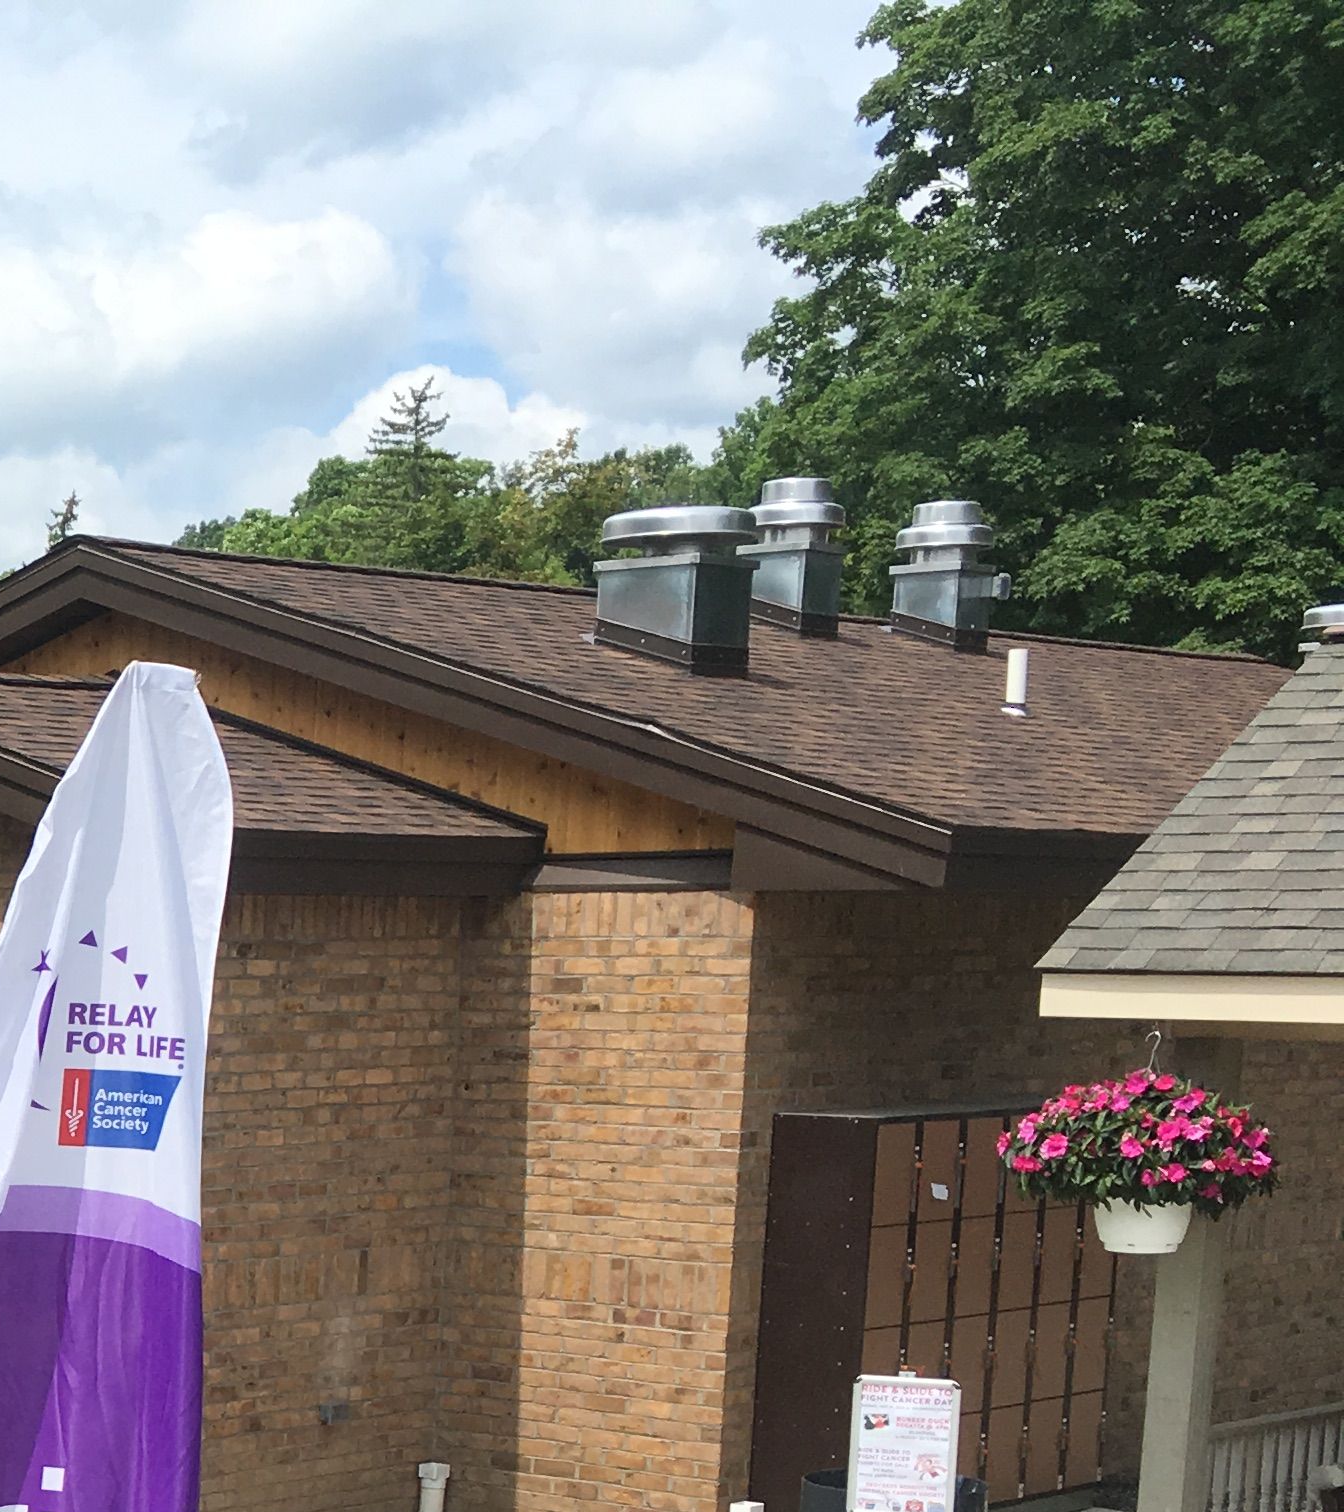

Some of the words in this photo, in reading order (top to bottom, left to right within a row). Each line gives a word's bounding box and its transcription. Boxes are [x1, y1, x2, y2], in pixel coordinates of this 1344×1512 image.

[67, 1002, 158, 1029] RELAY
[65, 1031, 127, 1056] FOR
[136, 1033, 186, 1061] LIFE
[94, 1088, 163, 1106] American
[93, 1102, 148, 1117] Cancer
[92, 1115, 149, 1135] Society
[862, 1384, 888, 1393] RIDE
[903, 1386, 934, 1396] SLIDE
[937, 1388, 953, 1397] TO
[861, 1394, 889, 1402] FIGHT
[892, 1396, 931, 1405] CANCER
[934, 1398, 953, 1406] DAY
